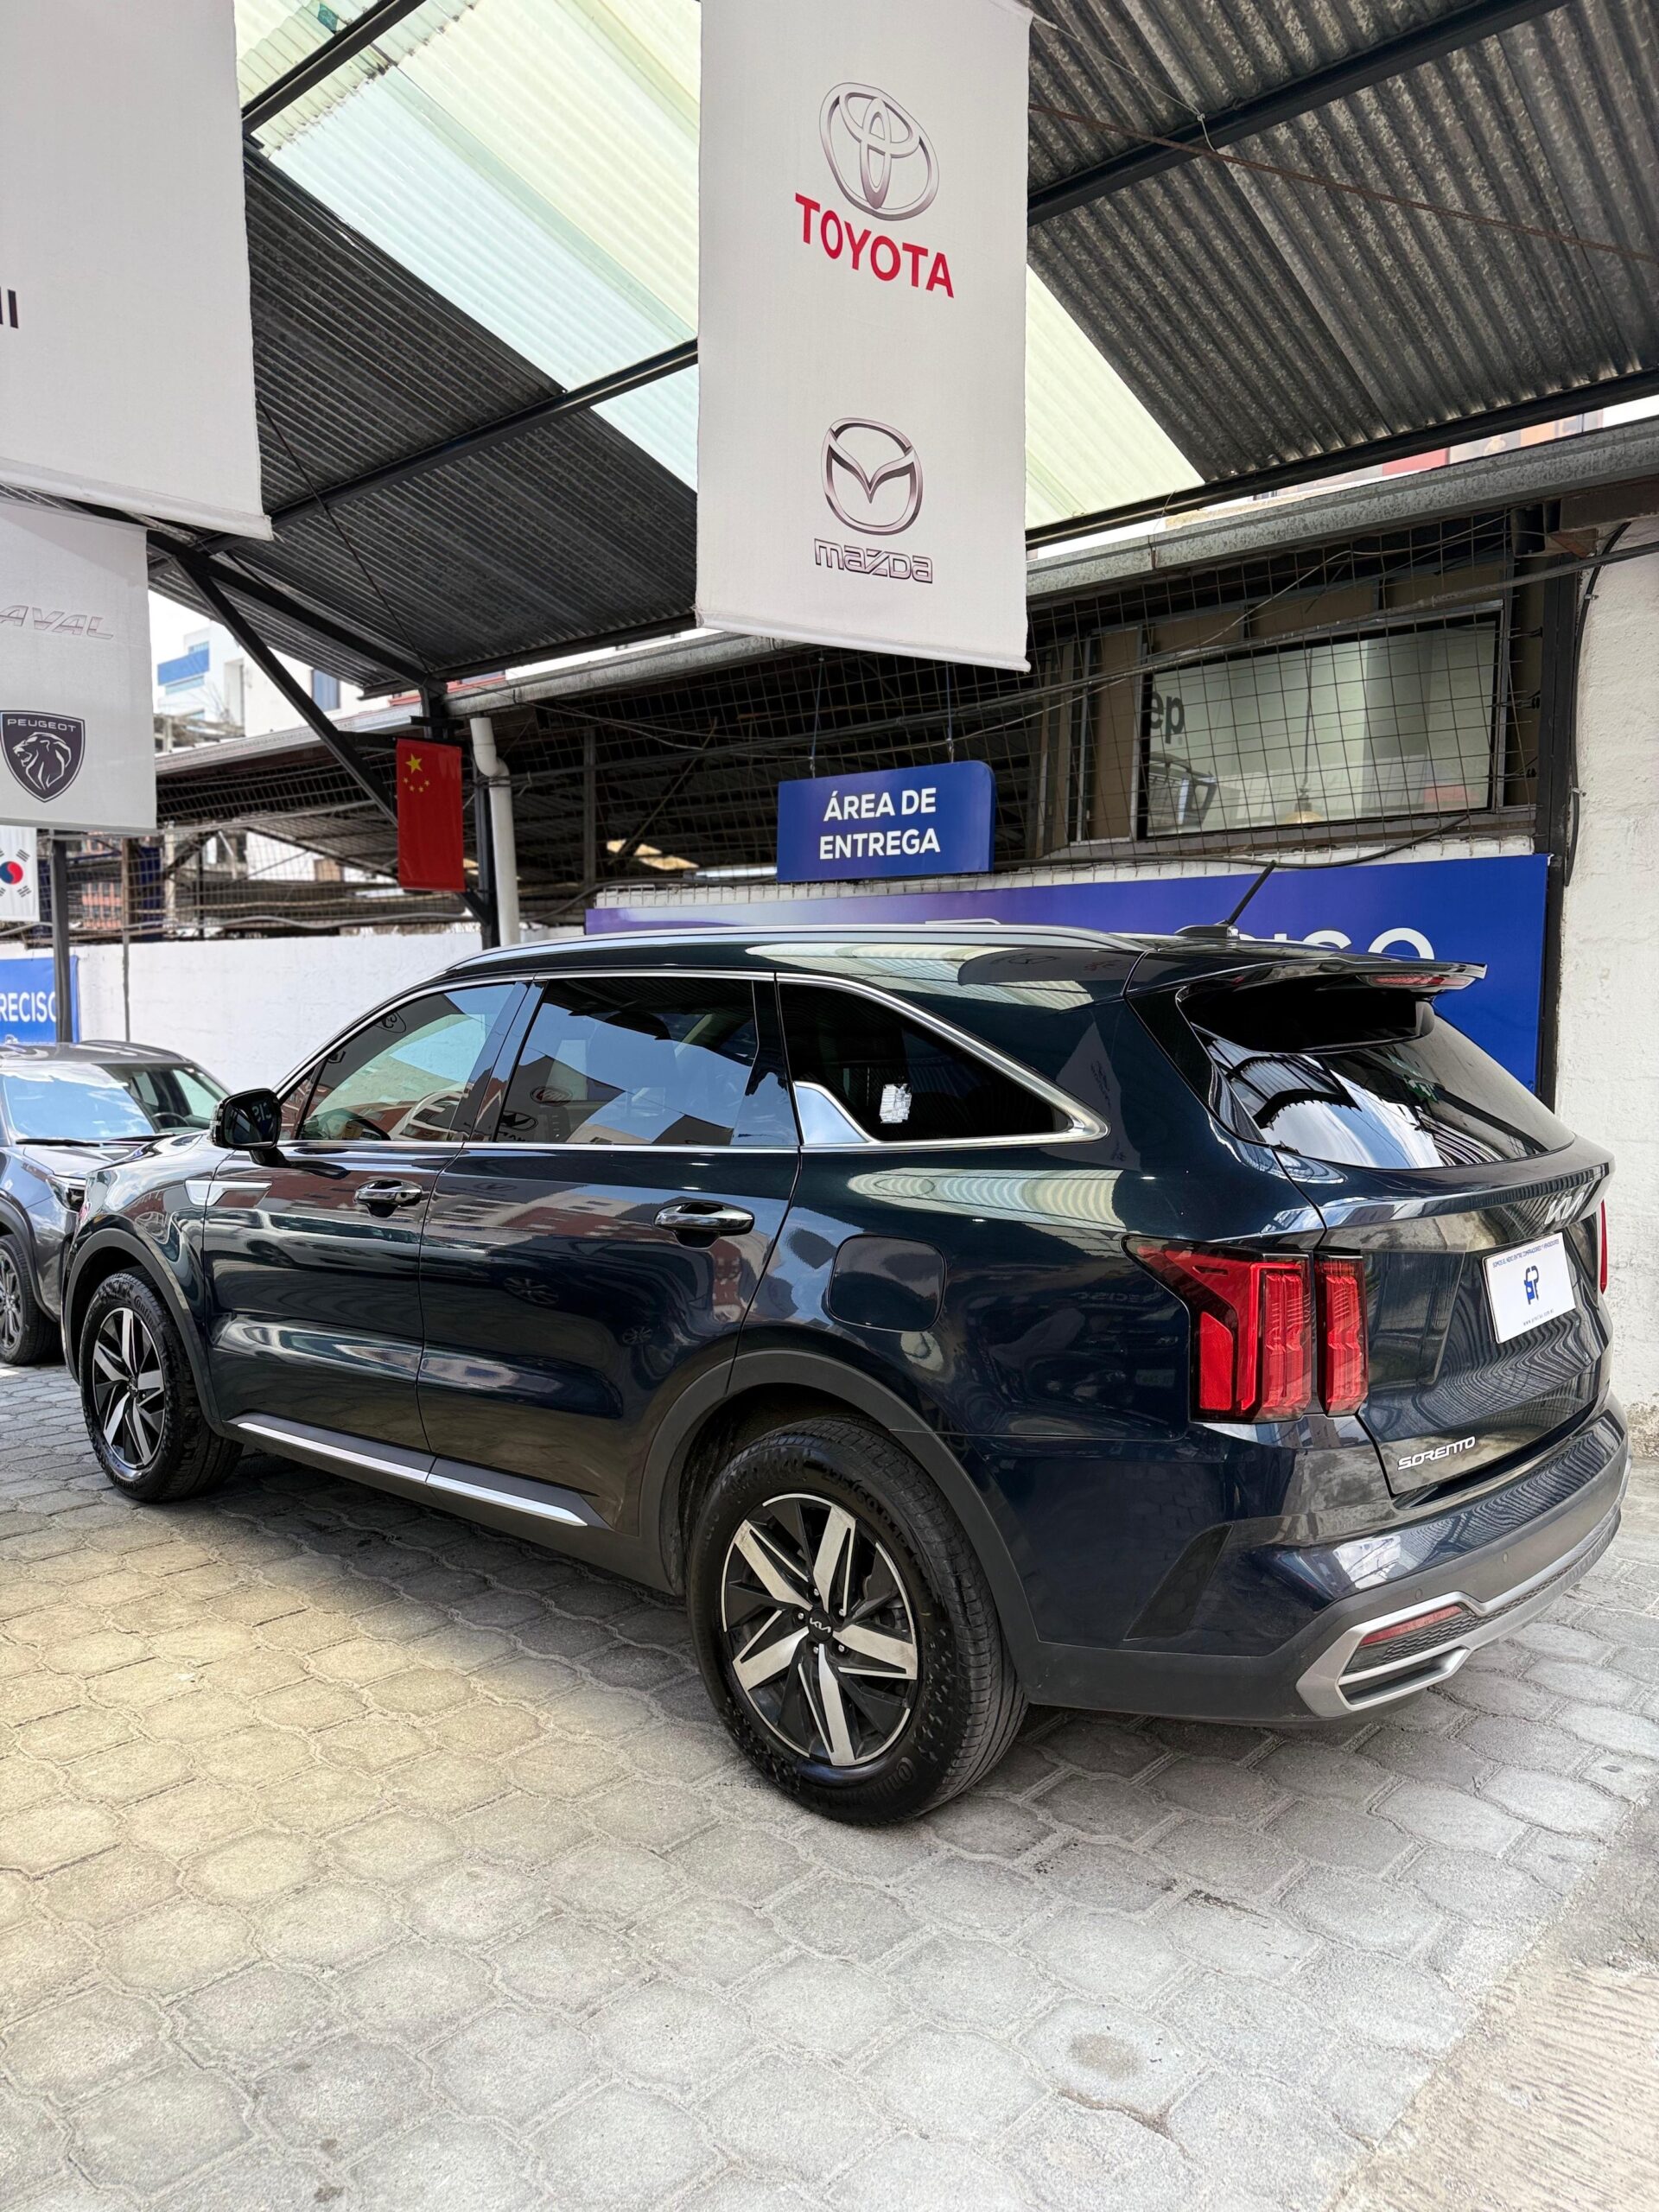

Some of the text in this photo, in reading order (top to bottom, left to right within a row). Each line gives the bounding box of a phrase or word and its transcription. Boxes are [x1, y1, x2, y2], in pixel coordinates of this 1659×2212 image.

[795, 193, 954, 298] TOYOTA
[0, 605, 114, 640] AVAL
[7, 718, 77, 733] PEUGEOT
[823, 787, 937, 822] ÁREA DE
[819, 828, 941, 860] ENTREGA
[1544, 1192, 1585, 1225] KIA
[1397, 1436, 1476, 1471] SORENTO
[809, 1617, 832, 1633] KIA
